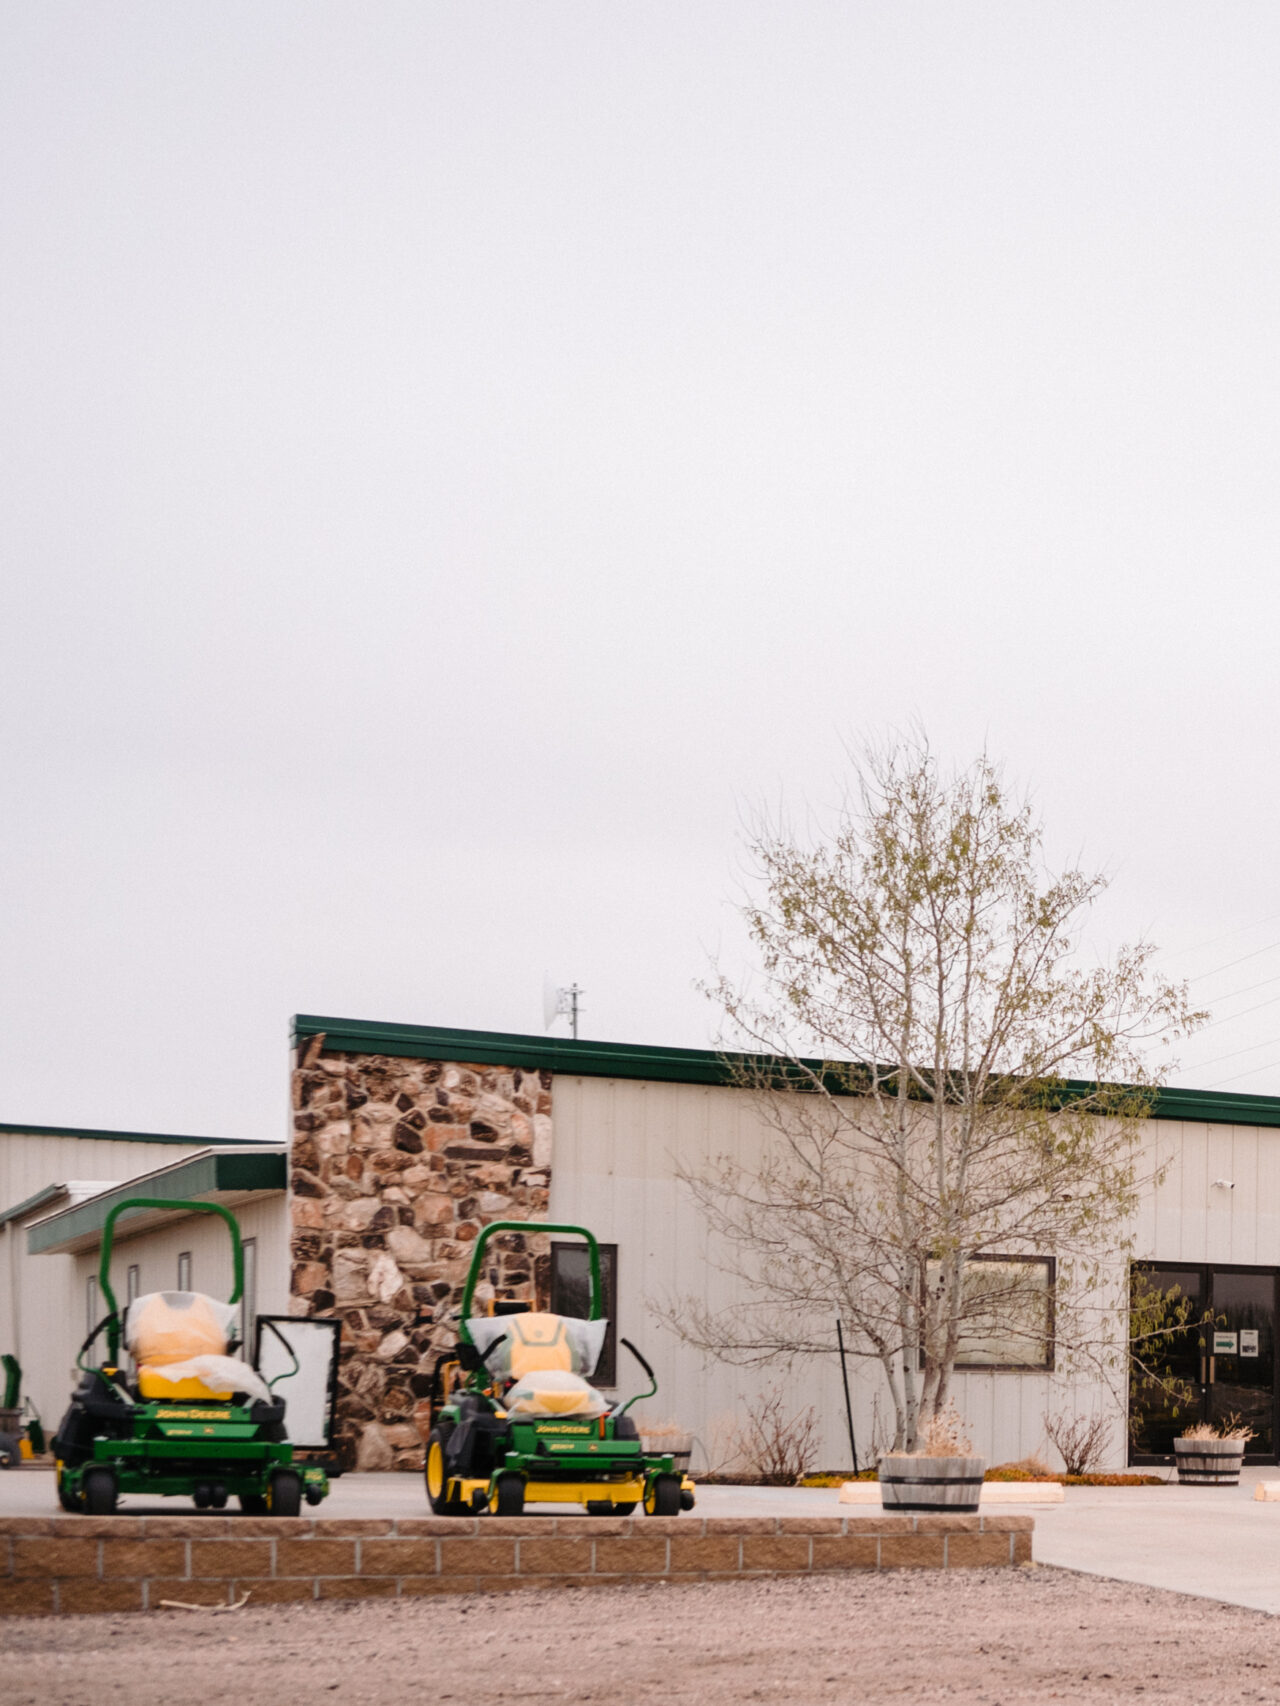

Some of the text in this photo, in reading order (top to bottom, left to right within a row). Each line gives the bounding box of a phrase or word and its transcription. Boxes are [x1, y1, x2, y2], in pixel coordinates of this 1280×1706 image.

[155, 1409, 231, 1419] JOHN DEERE
[536, 1425, 590, 1434] JOHN DEERE
